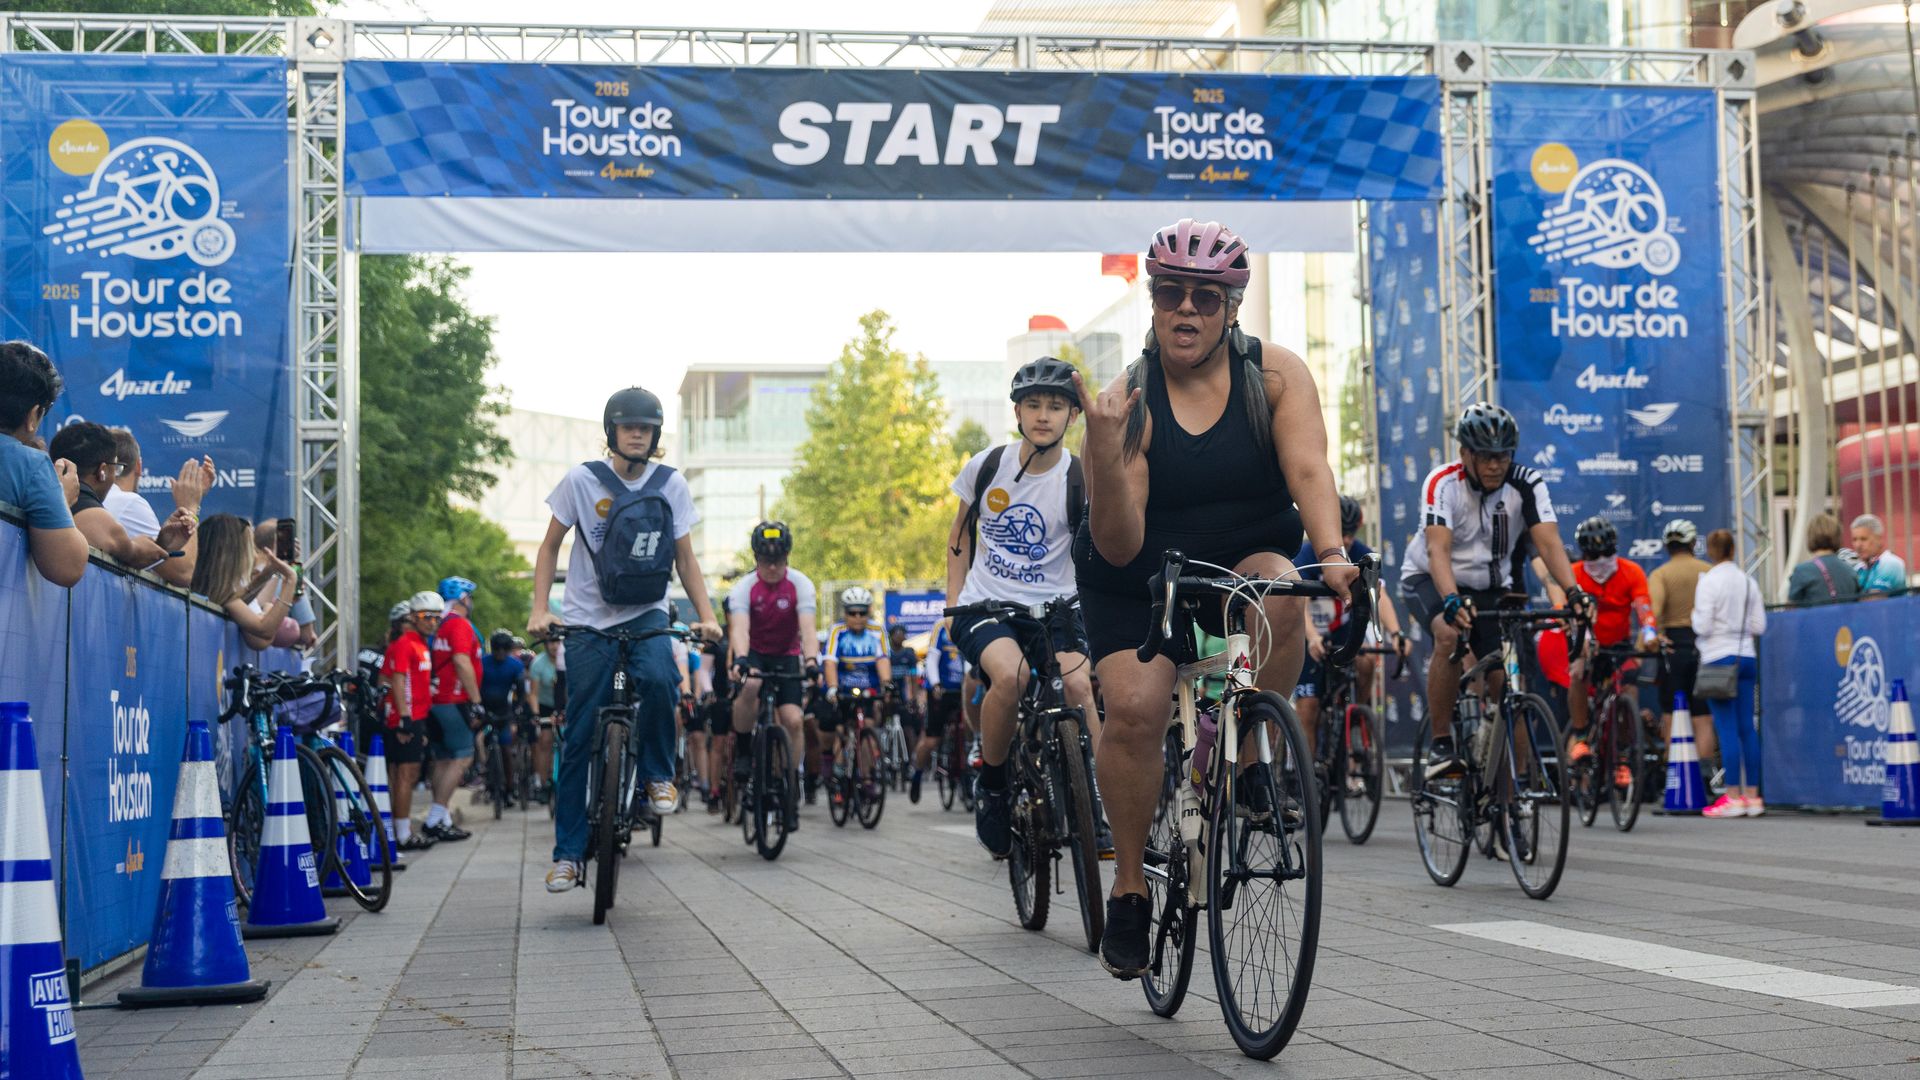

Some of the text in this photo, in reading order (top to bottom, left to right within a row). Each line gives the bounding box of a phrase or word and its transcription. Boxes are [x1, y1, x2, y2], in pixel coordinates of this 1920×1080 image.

[595, 81, 629, 97] 2025
[1193, 88, 1224, 104] 2025
[551, 99, 673, 129] Tour de
[1153, 106, 1265, 135] Tour de
[543, 126, 682, 157] Houston
[771, 100, 1062, 166] START
[1146, 132, 1273, 161] Houston
[42, 271, 232, 305] 2025 Tour de
[1558, 277, 1633, 309] Tour
[1634, 279, 1679, 309] de
[70, 304, 243, 339] Houston
[1551, 306, 1688, 337] Houston
[100, 367, 192, 401] Apache
[1575, 363, 1650, 393] Apache
[211, 469, 256, 488] NE
[110, 690, 150, 754] Tour de
[1844, 735, 1873, 760] Tour
[1842, 760, 1887, 785] Housto
[109, 758, 152, 823] Houston
